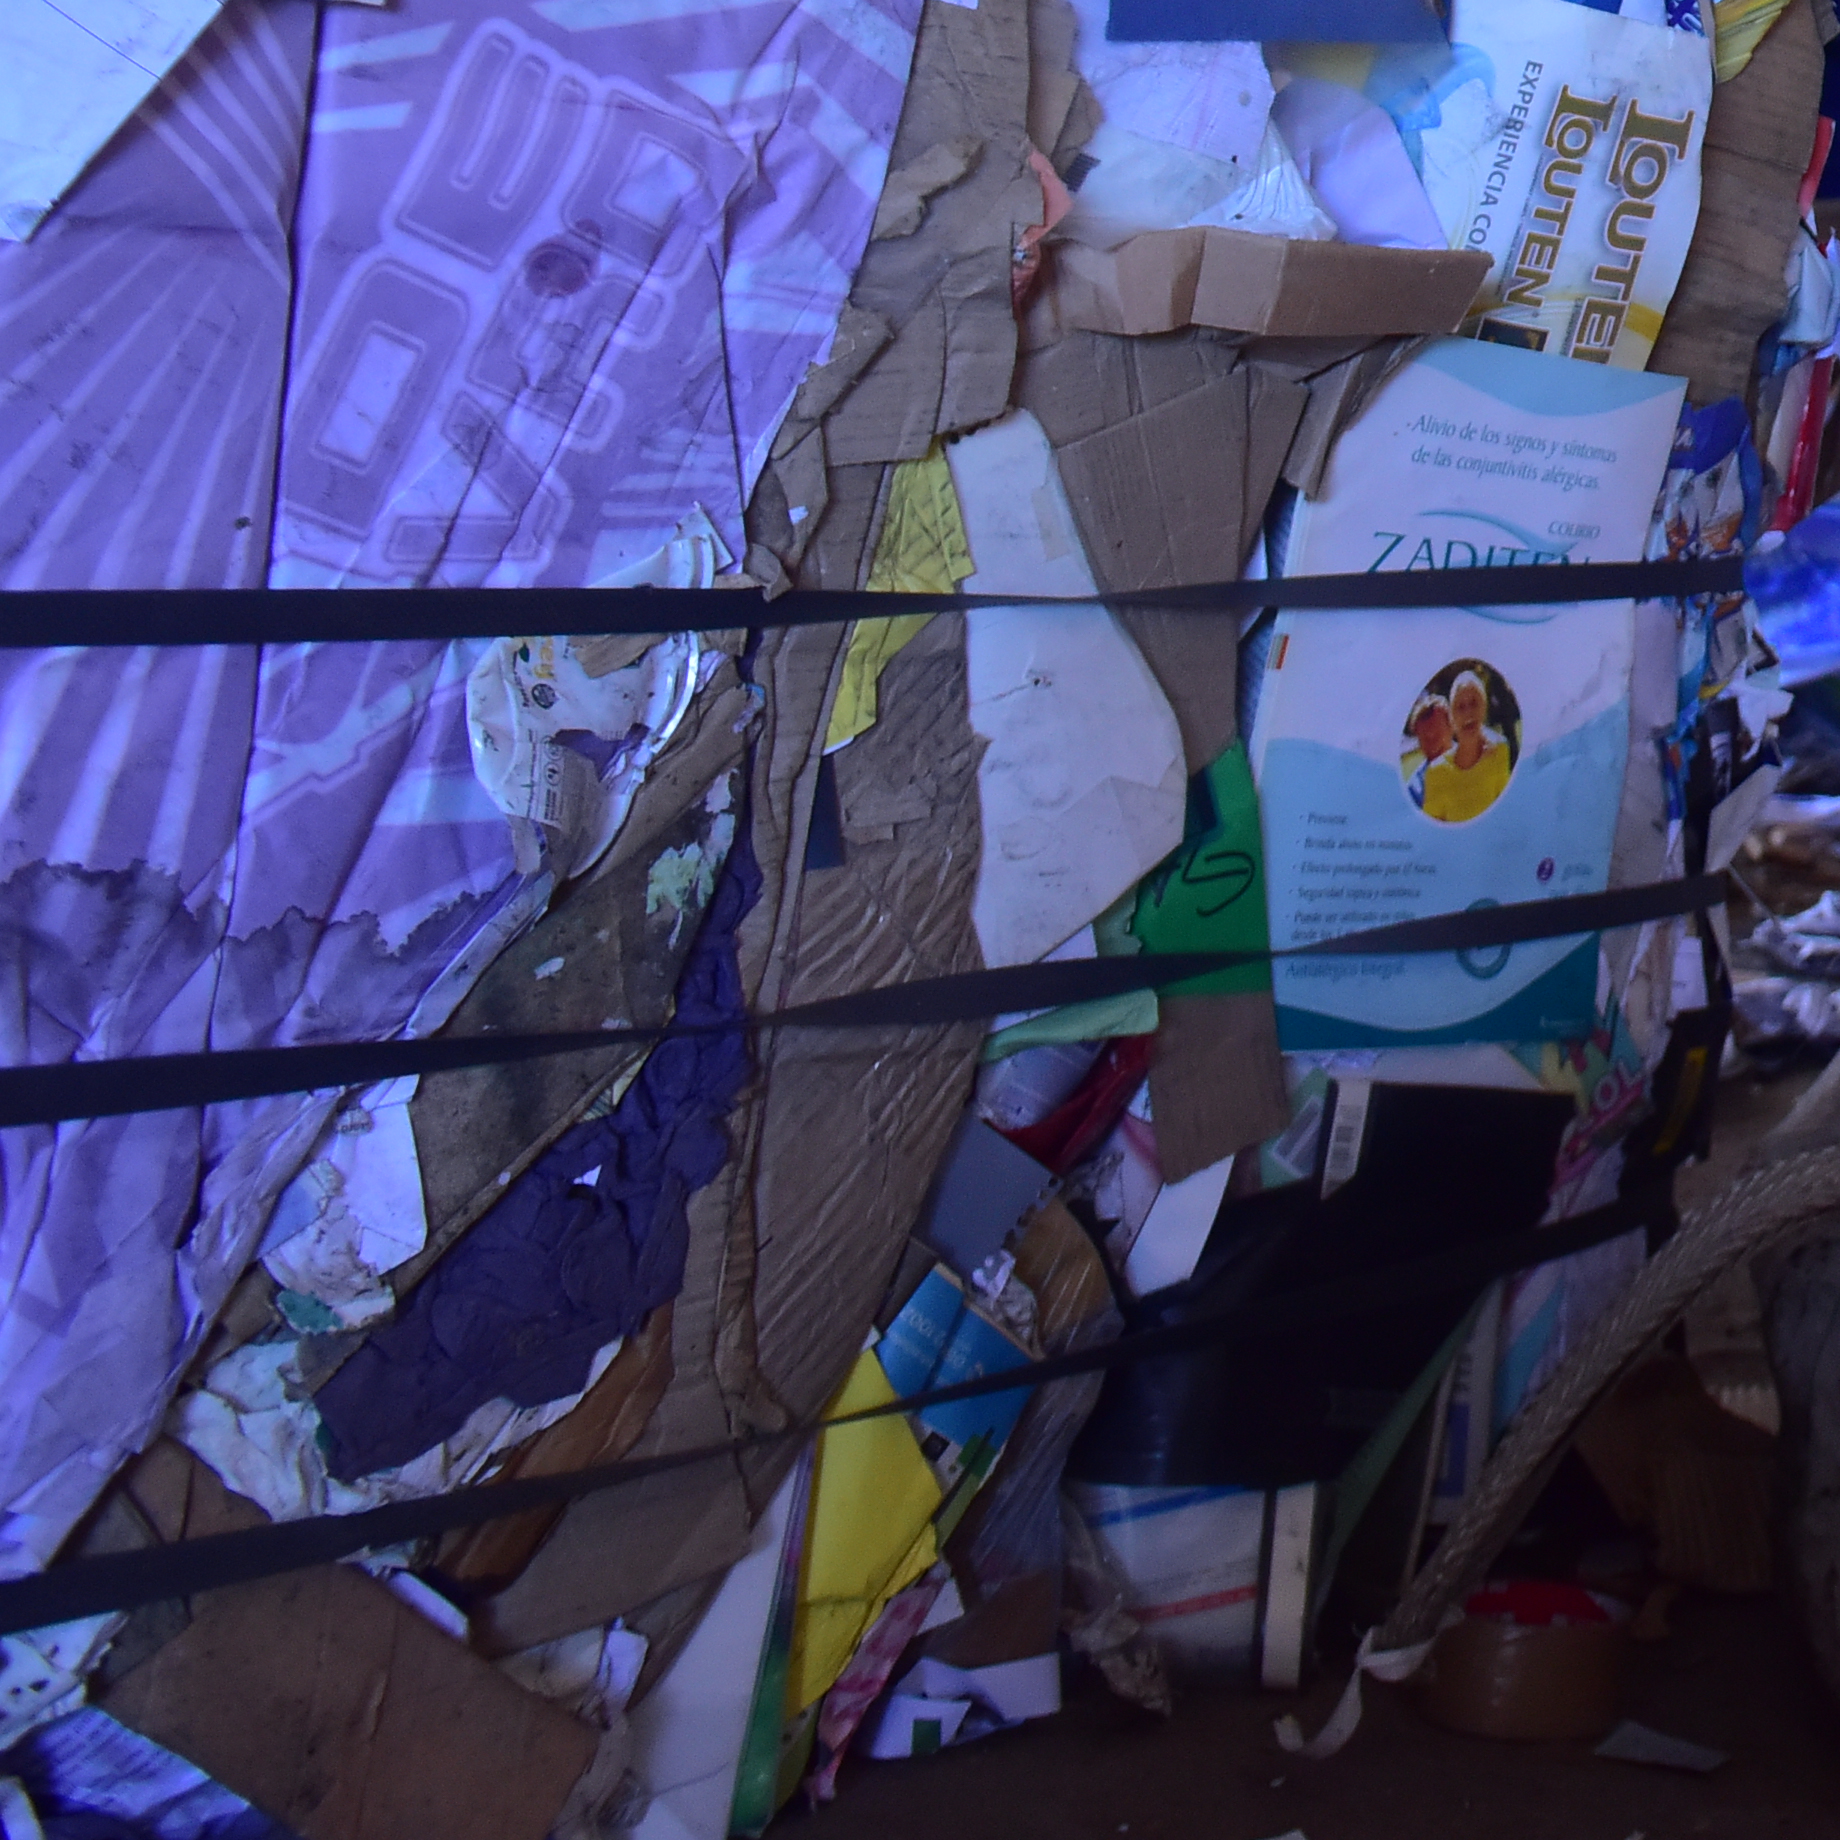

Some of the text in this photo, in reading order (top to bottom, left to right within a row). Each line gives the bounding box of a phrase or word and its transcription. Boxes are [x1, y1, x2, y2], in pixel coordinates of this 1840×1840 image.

[1476, 59, 1544, 208] EXPERIENCIA
[1503, 84, 1622, 320] LOUTEN
[1411, 445, 1431, 464] de
[1433, 447, 1452, 467] las
[1456, 453, 1538, 480] conjuntivitis
[1412, 414, 1618, 464] Alivio de los signos y síntomas
